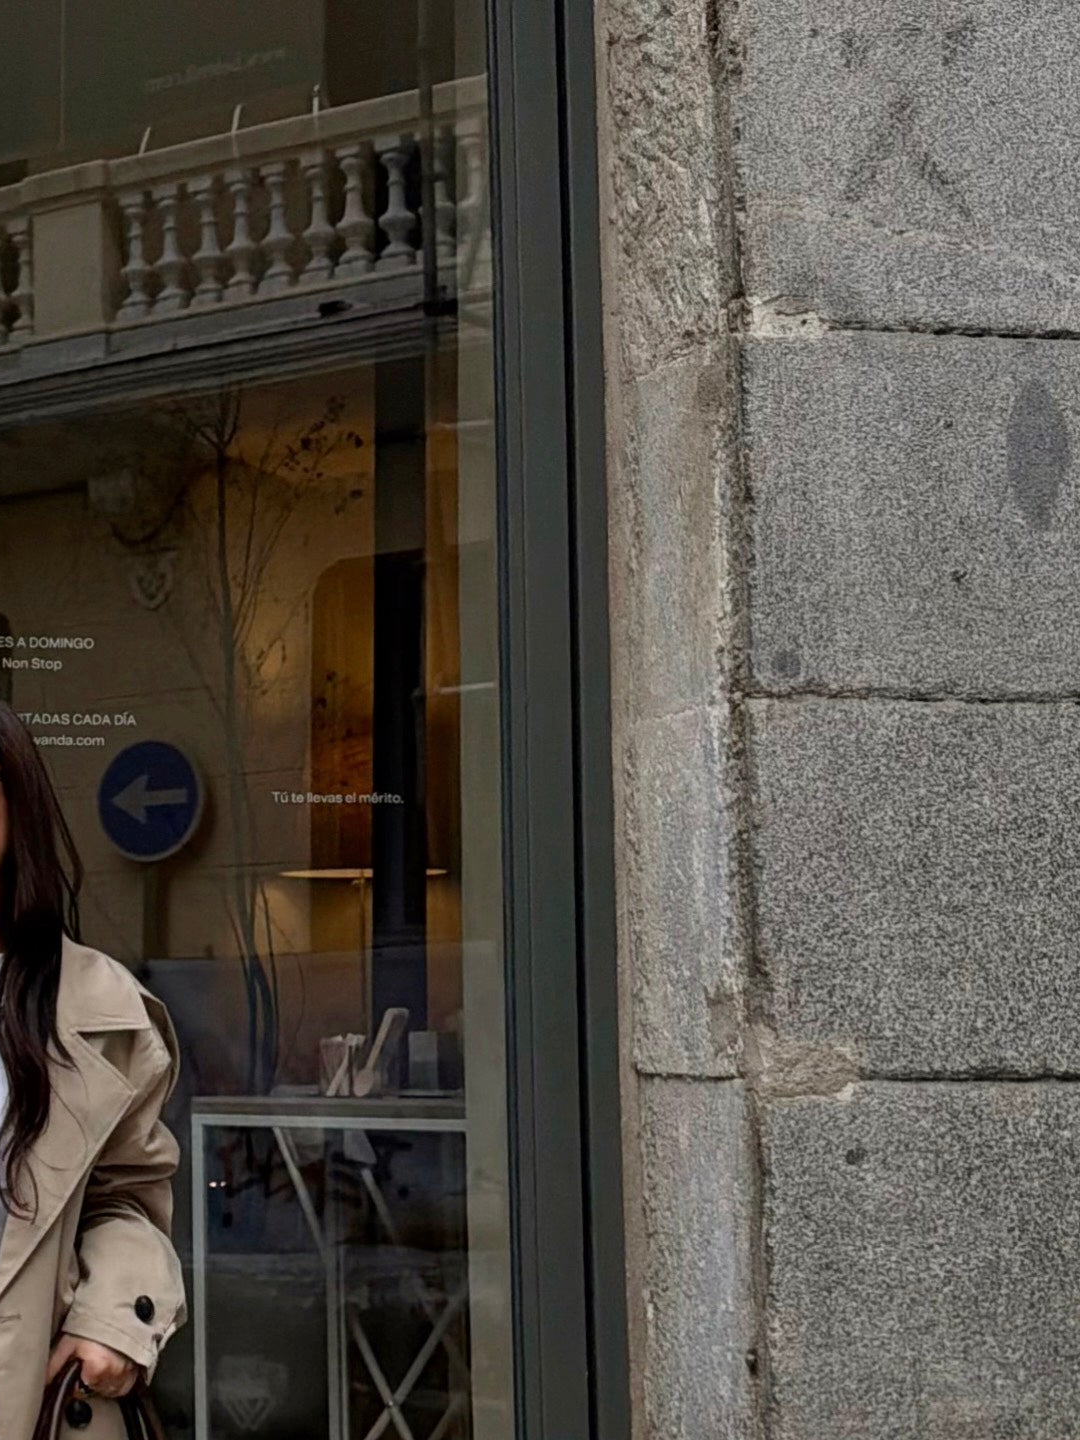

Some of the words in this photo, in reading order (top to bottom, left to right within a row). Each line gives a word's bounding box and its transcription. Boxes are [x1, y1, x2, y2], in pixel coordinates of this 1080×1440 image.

[16, 637, 26, 648] A
[29, 637, 95, 649] DOMINGO
[2, 658, 29, 669] Non
[32, 658, 63, 671] Stop
[73, 713, 111, 725] CADA
[115, 711, 137, 726] DÍA
[272, 791, 289, 804] Tú
[291, 792, 305, 804] te
[307, 792, 343, 804] llevas
[345, 792, 357, 804] el
[359, 791, 405, 804] mérito.
